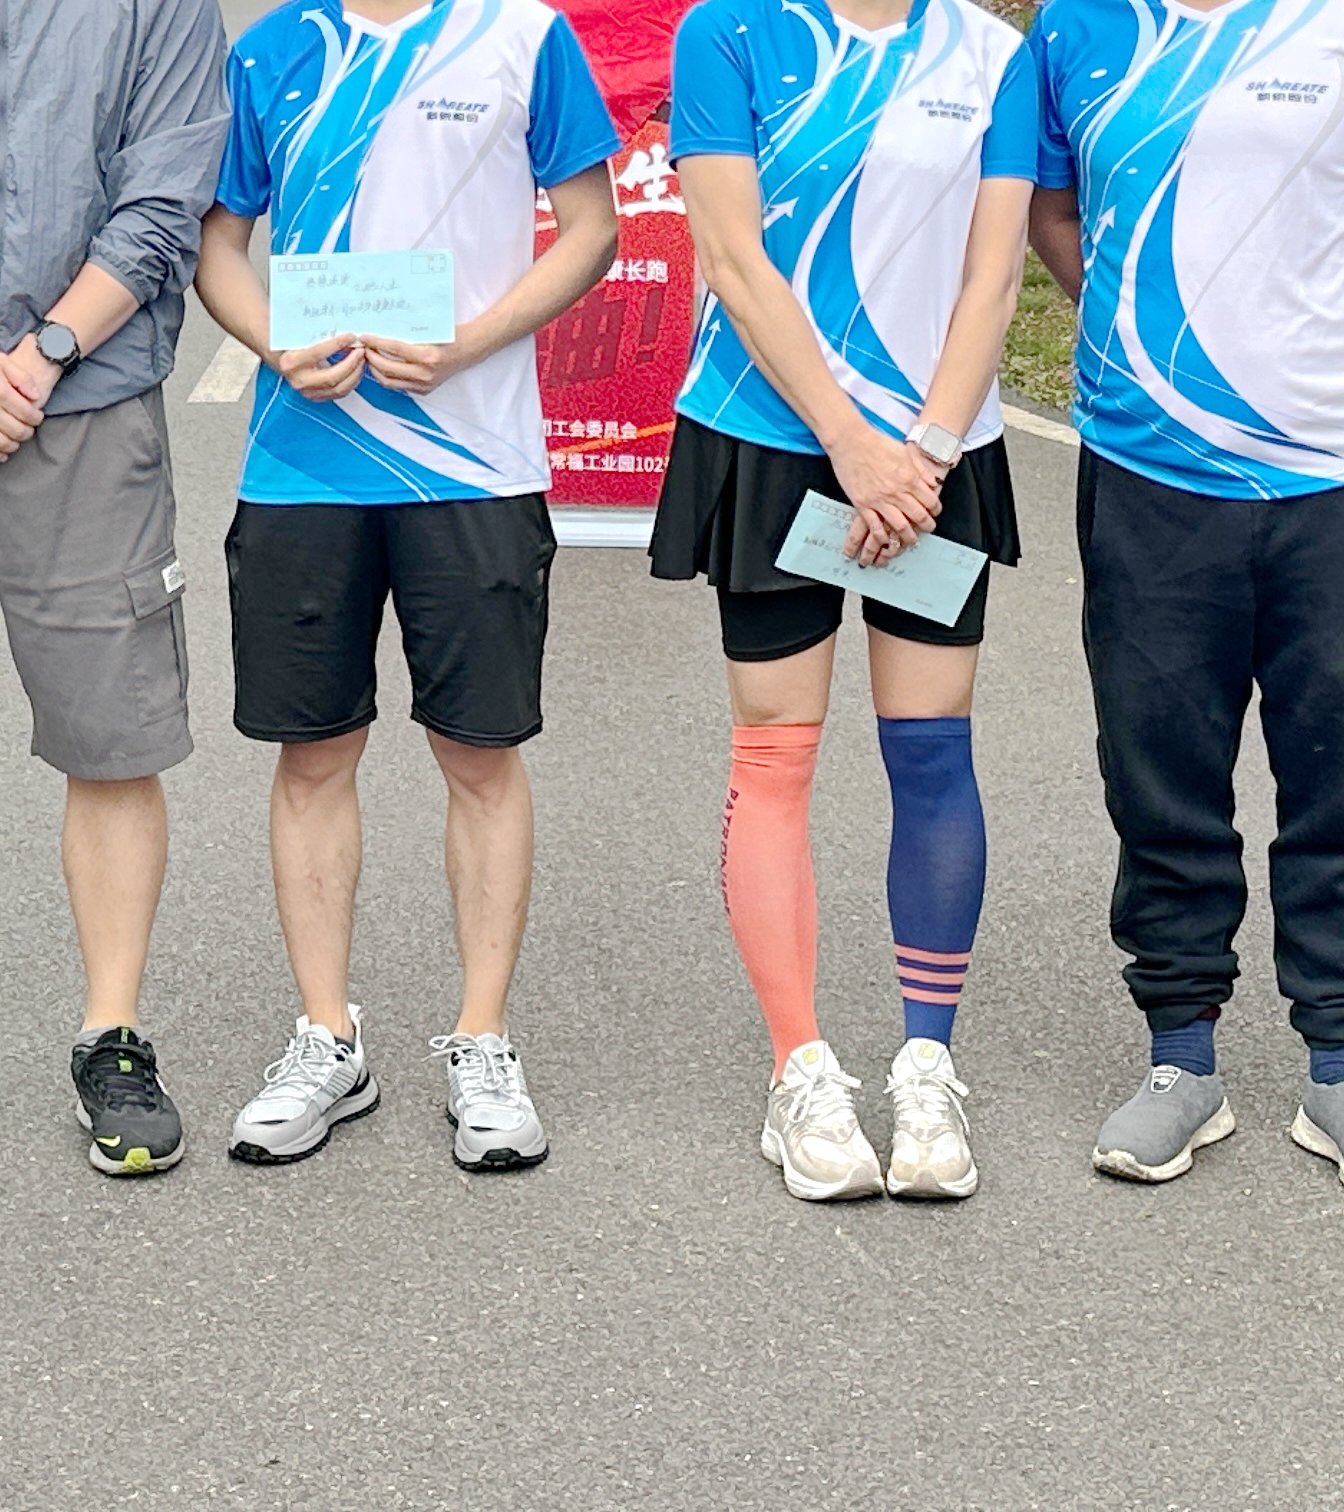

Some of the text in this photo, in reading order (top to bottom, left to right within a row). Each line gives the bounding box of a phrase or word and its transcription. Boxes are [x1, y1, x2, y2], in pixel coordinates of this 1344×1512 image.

[549, 452, 670, 473] 常福工业园102
